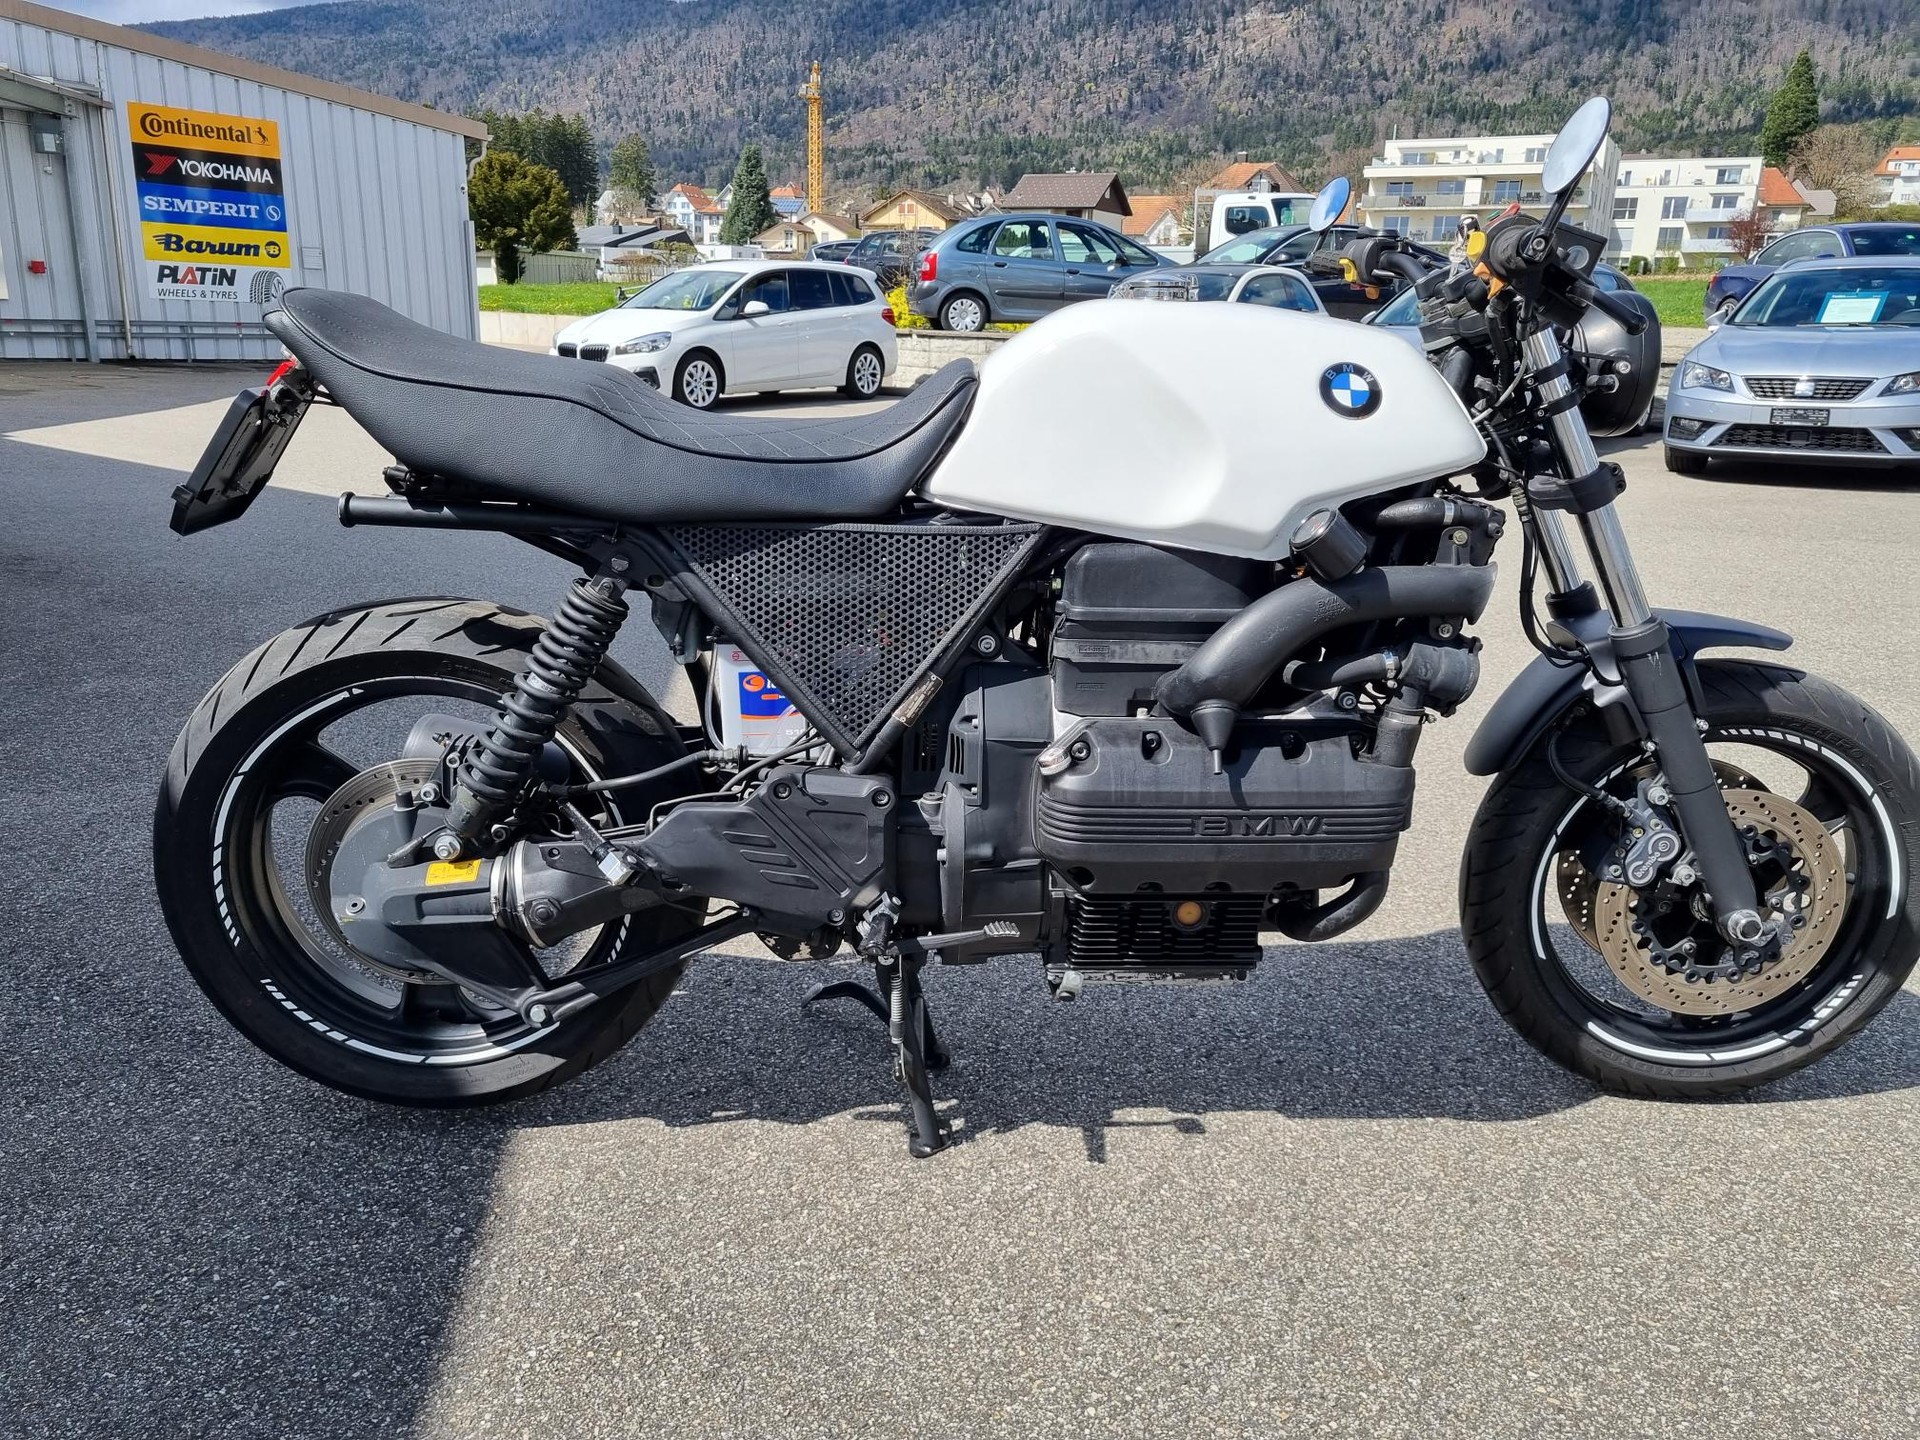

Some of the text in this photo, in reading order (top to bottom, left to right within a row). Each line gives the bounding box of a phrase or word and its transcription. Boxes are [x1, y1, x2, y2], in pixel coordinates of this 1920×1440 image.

[140, 112, 252, 144] Continental
[177, 158, 274, 184] YOKOHAMA
[143, 195, 260, 219] SEMPERIT
[152, 233, 261, 257] Barum
[157, 288, 238, 300] WHEELS & TYRES
[1325, 364, 1375, 382] BMW
[1200, 815, 1320, 836] BMW
[1633, 851, 1661, 878] brembo
